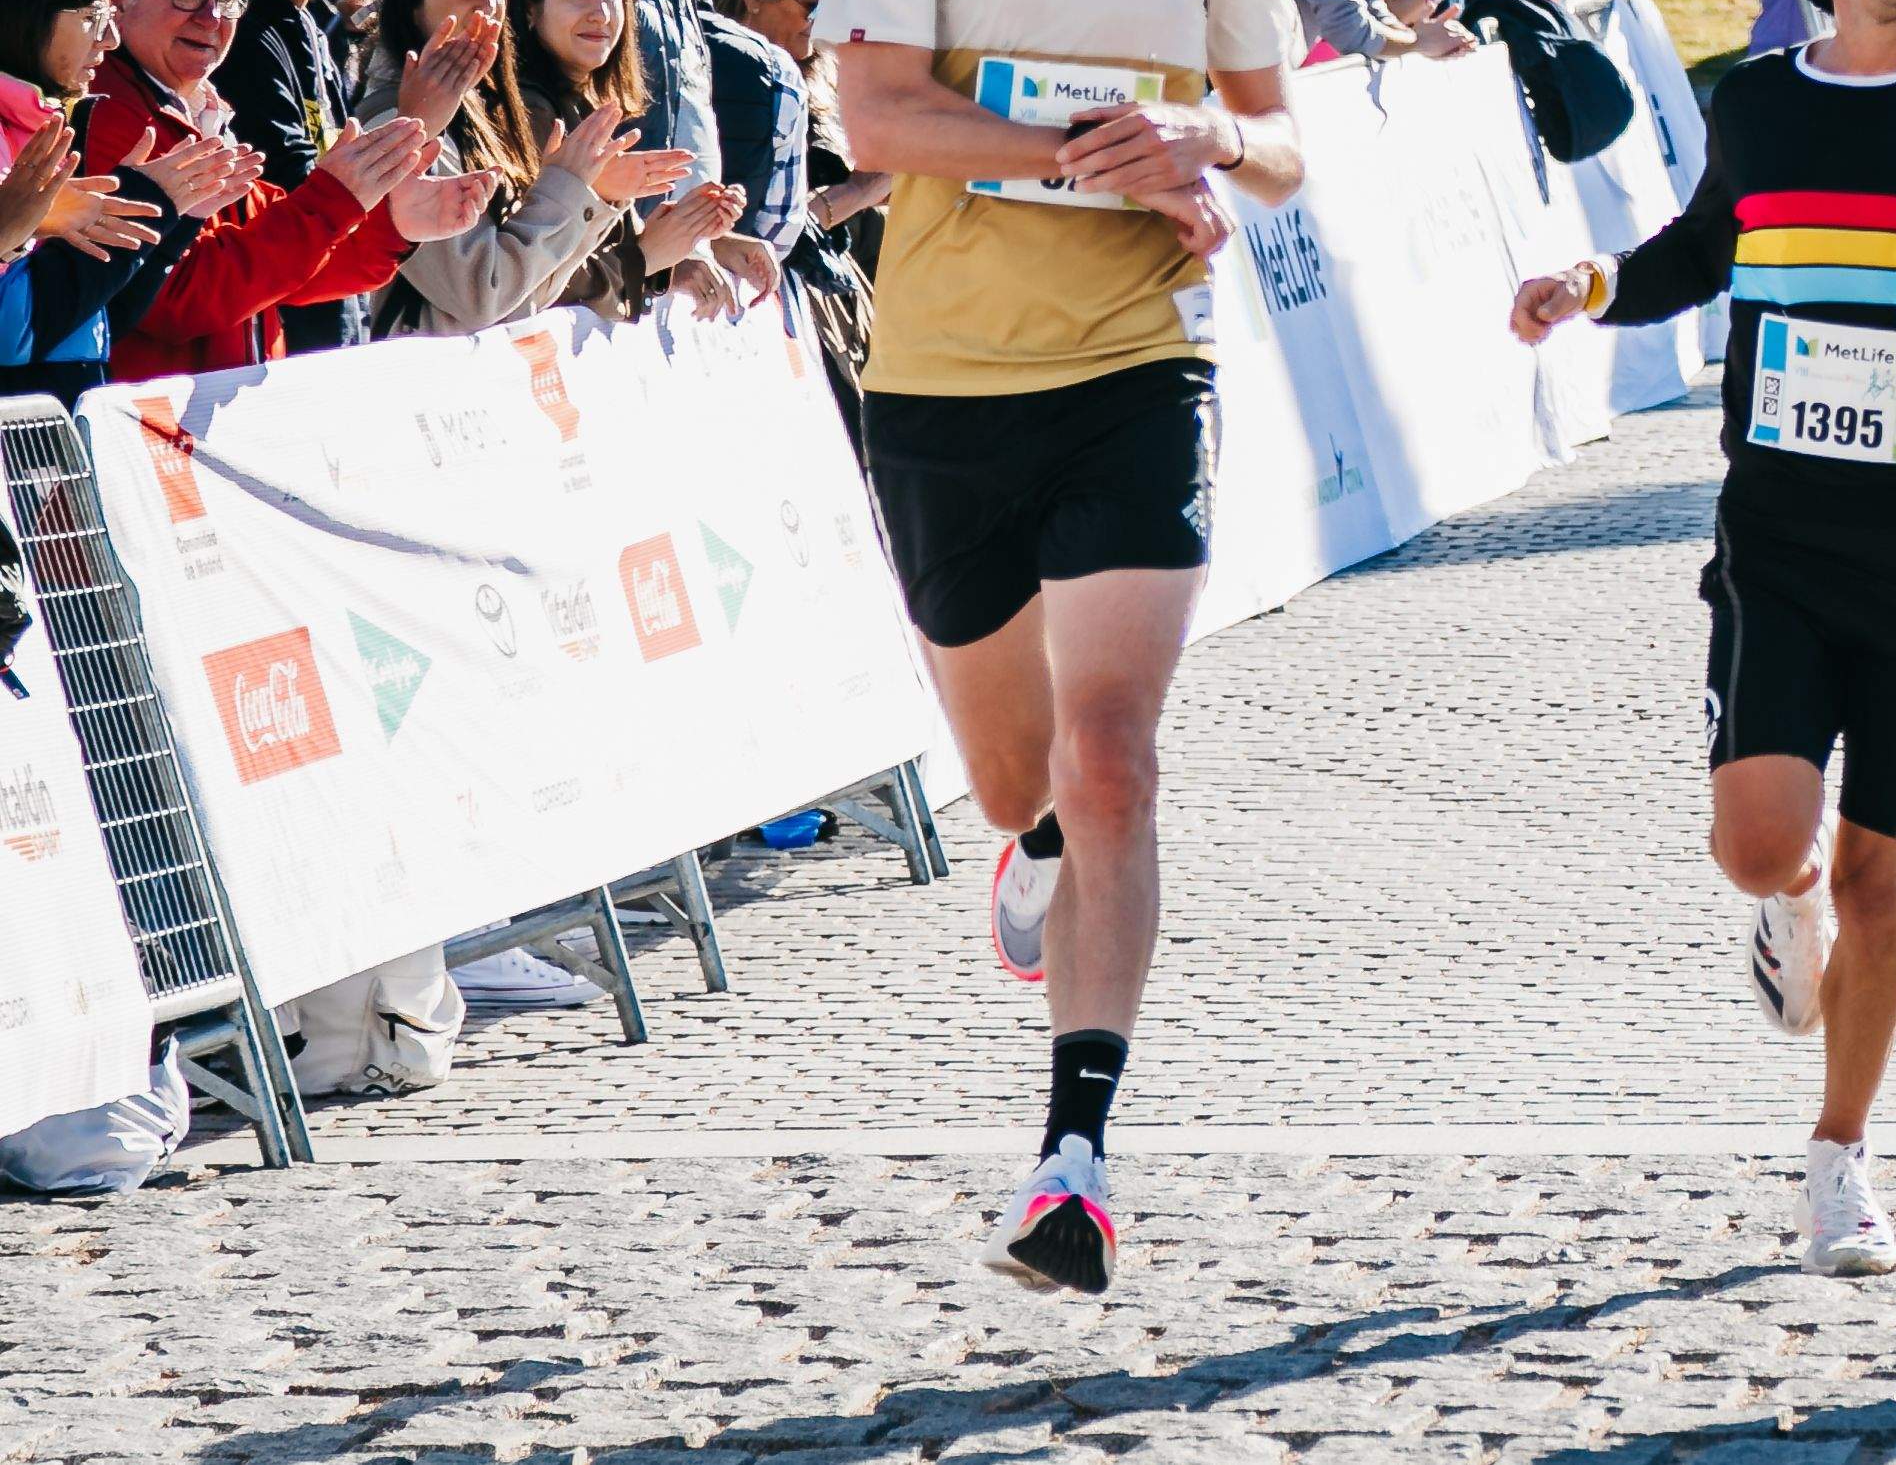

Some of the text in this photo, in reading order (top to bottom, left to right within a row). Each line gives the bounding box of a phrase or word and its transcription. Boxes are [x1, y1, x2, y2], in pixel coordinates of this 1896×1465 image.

[1054, 82, 1126, 105] MetLife
[1245, 208, 1327, 316] MetLife
[1824, 342, 1895, 364] MetLife
[1790, 400, 1883, 448] 1395
